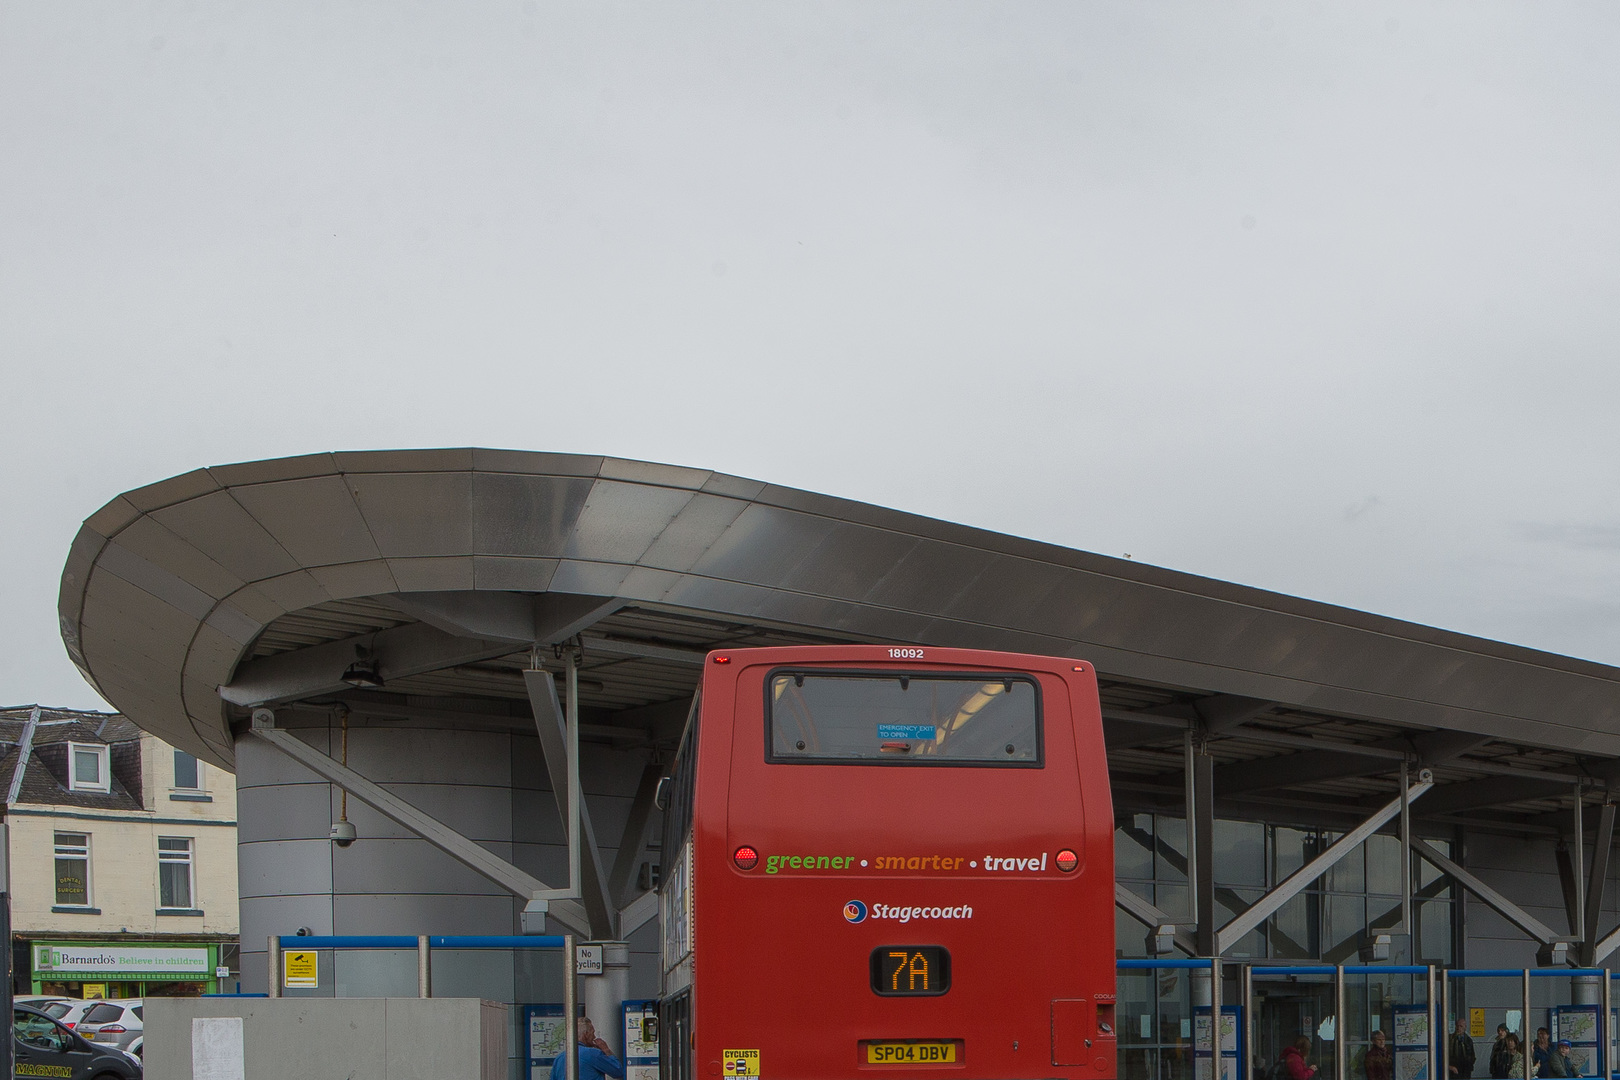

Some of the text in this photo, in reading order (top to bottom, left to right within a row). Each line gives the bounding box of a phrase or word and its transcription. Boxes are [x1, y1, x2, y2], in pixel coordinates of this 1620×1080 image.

[888, 648, 924, 658] 18092
[765, 853, 1047, 874] greener smarter travel
[59, 877, 82, 885] DENTAL
[871, 903, 973, 923] Stagecoach
[61, 953, 205, 965] Barnardo's Believe in children
[581, 949, 592, 958] No
[889, 952, 928, 990] 7A
[724, 1050, 758, 1058] CYCLISTS
[874, 1046, 949, 1061] SP04 DBV
[15, 1063, 72, 1078] MAGNUM
